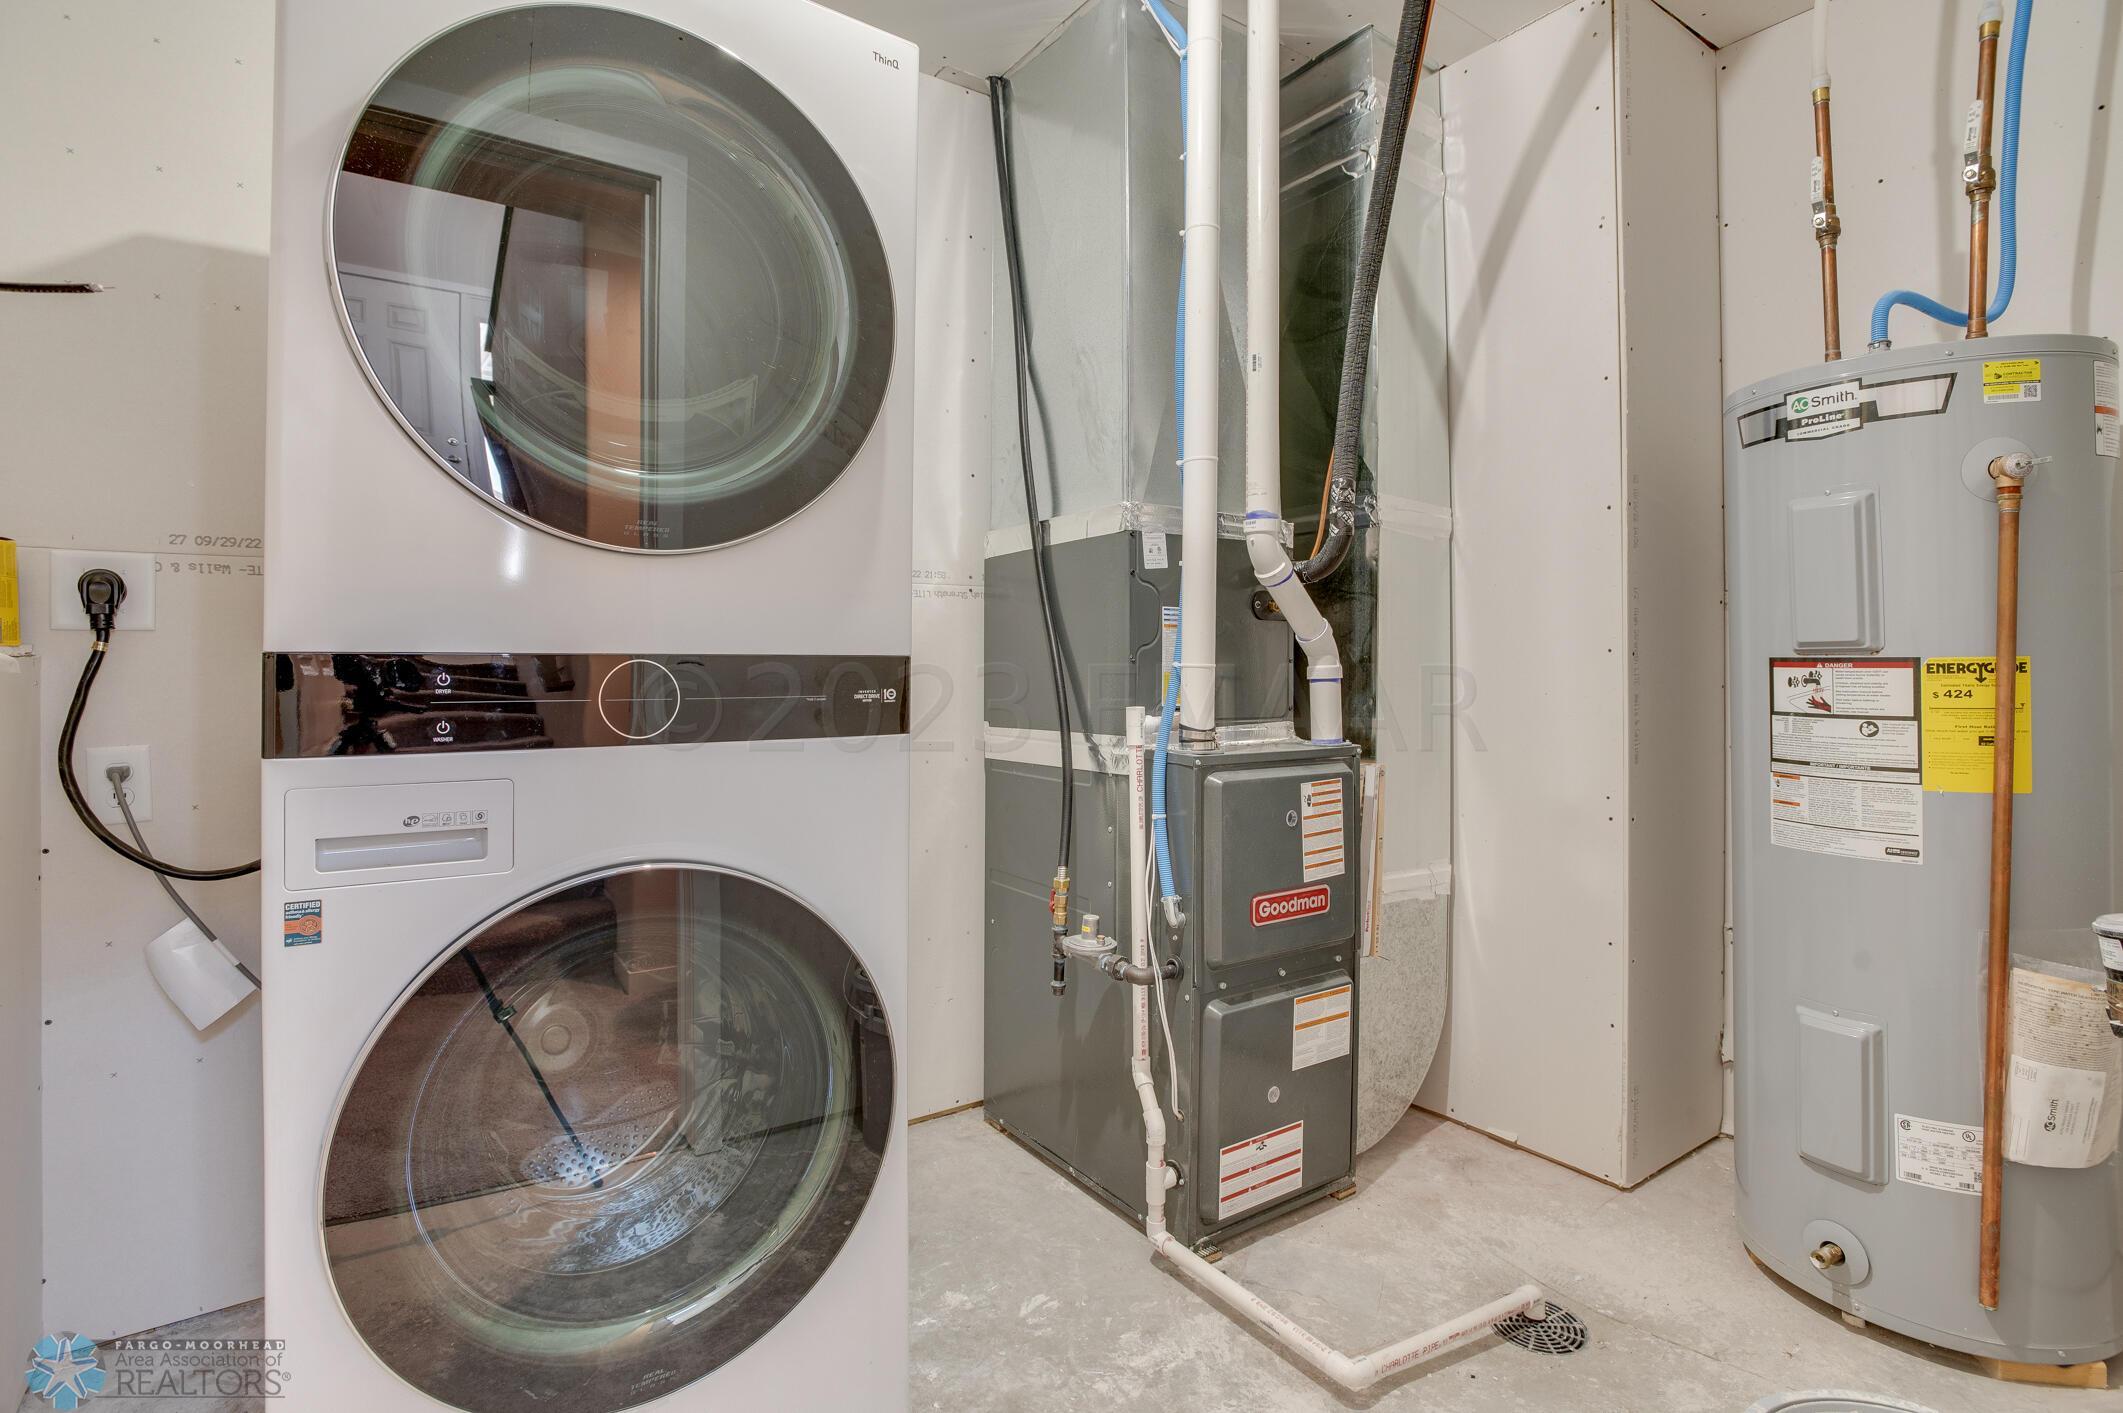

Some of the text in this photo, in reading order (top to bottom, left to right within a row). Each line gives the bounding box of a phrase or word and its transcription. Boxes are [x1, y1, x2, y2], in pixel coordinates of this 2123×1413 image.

[872, 51, 900, 70] ThinQ
[1811, 391, 1855, 407] Smith
[1801, 413, 1844, 426] ProLine
[168, 534, 264, 549] 27 09/29/22
[188, 562, 232, 575] Walls
[1943, 689, 1974, 699] 424
[285, 901, 321, 911] CERTIFIED
[1258, 894, 1327, 918] Goodman
[1381, 1350, 1420, 1374] CHARLOTTE
